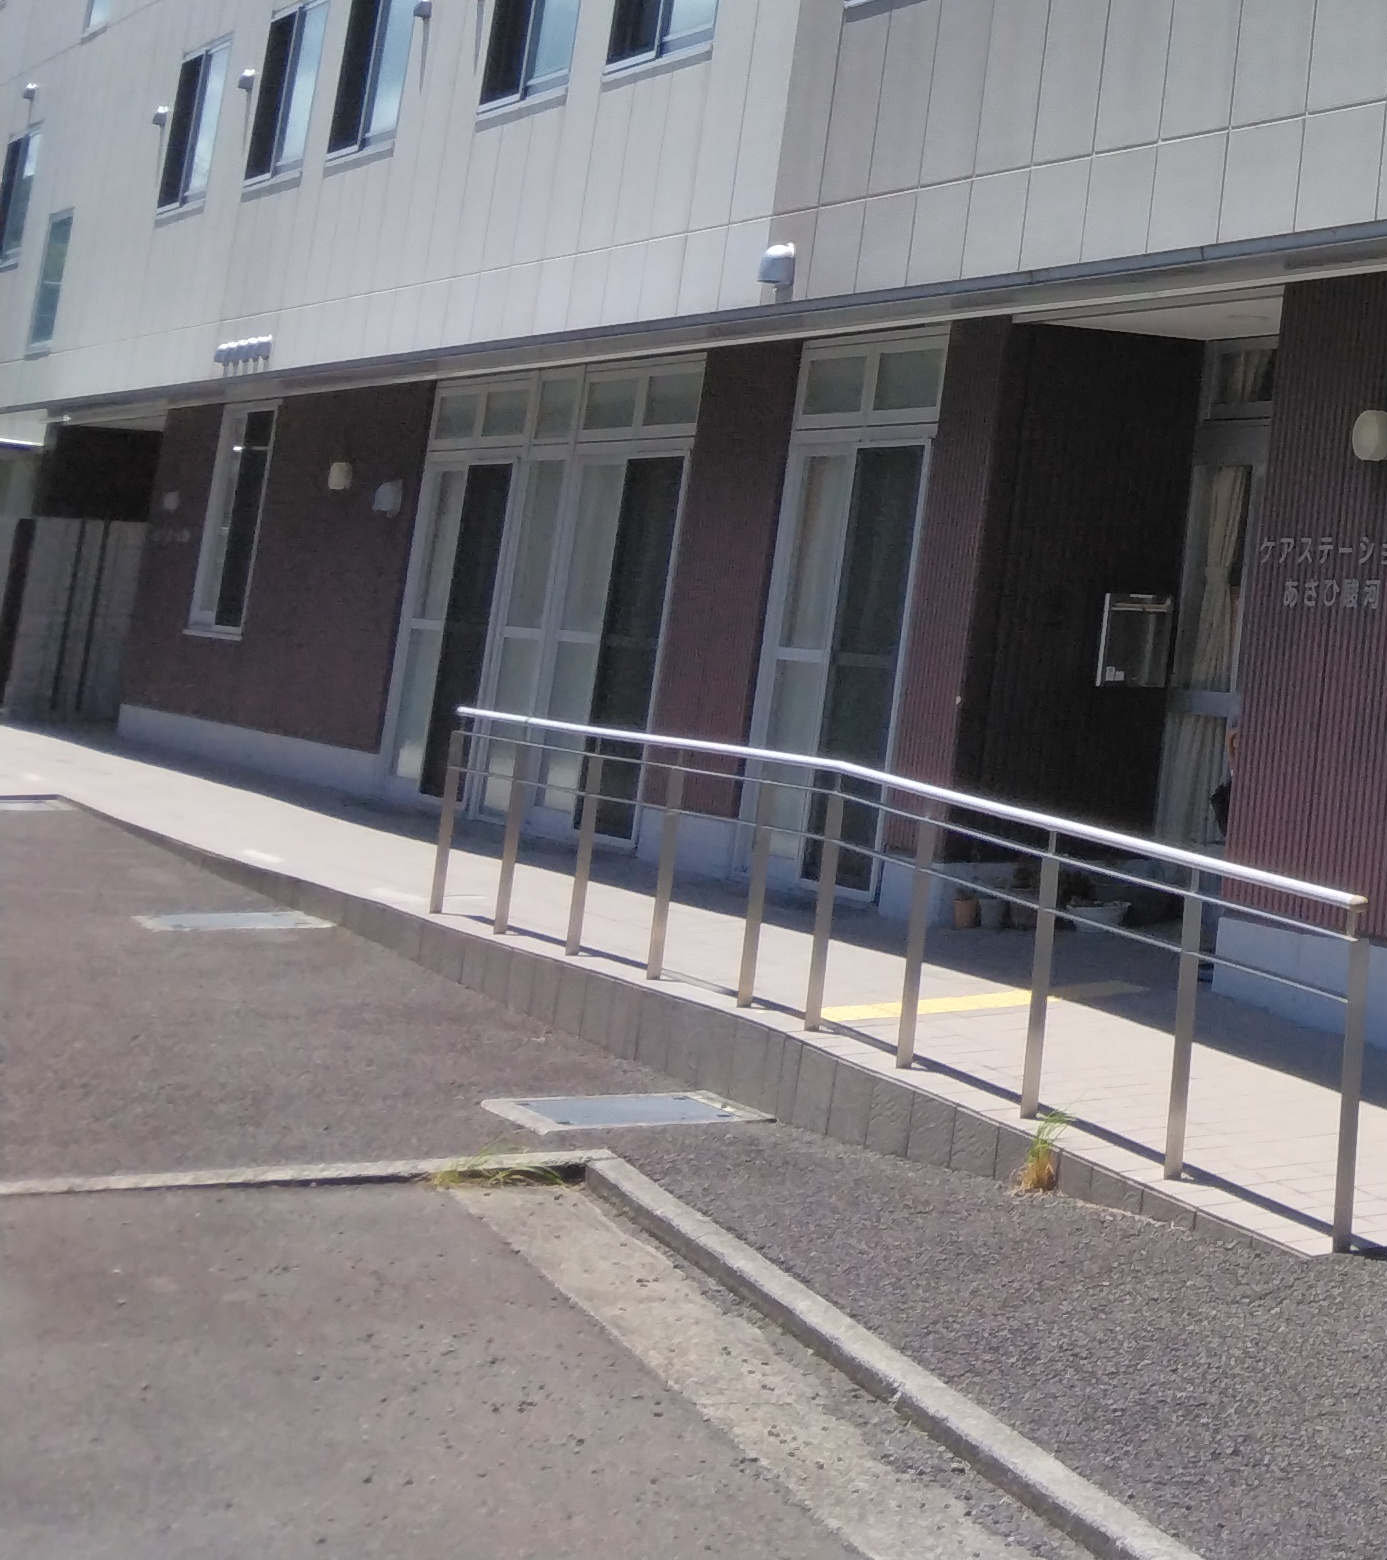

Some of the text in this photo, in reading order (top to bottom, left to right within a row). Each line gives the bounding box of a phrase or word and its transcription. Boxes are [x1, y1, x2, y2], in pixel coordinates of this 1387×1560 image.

[1283, 578, 1382, 610] あさひ駿河
